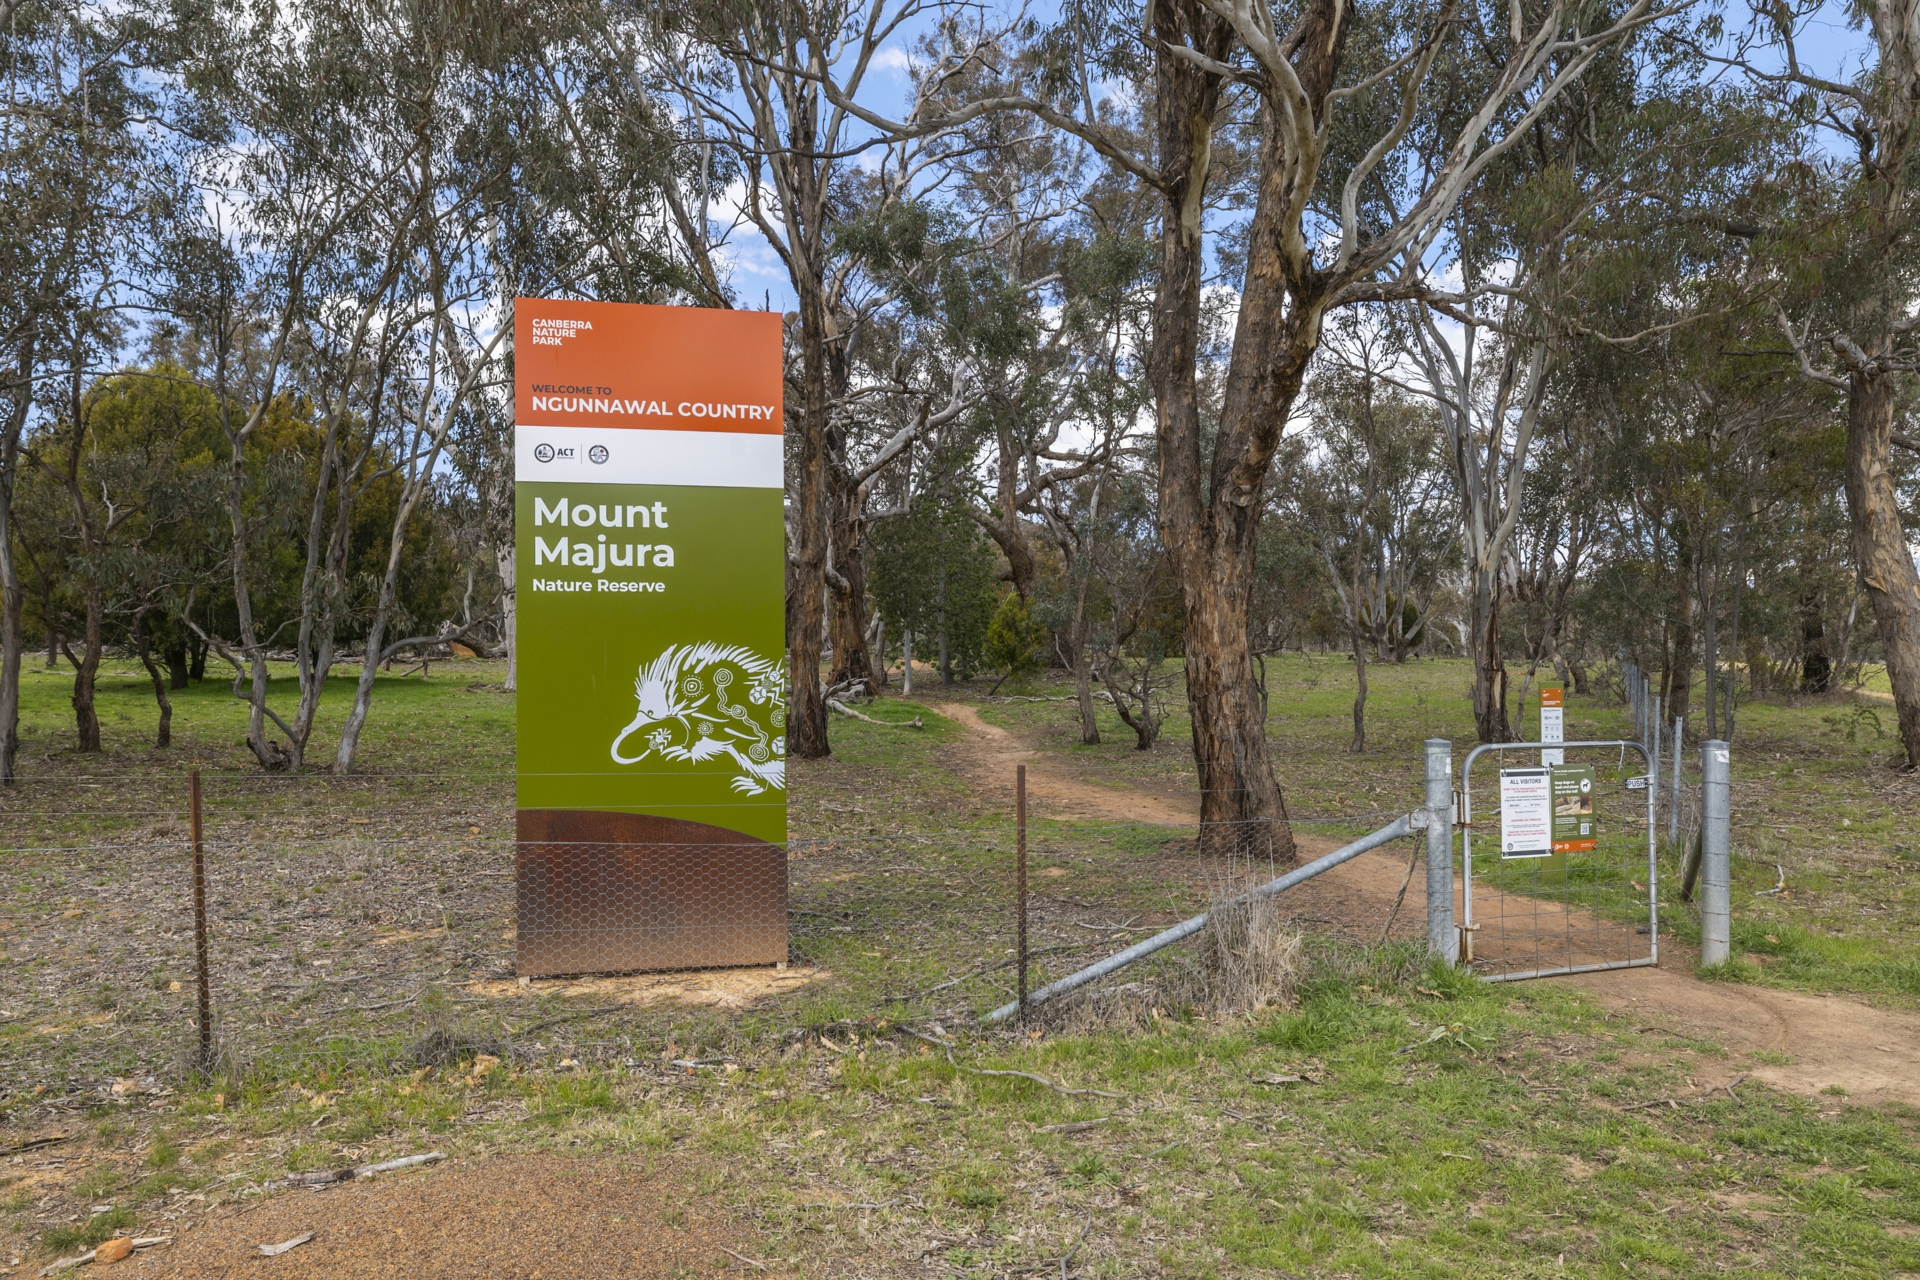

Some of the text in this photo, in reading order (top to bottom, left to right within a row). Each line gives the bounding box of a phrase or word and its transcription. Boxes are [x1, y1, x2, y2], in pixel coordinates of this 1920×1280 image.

[532, 318, 593, 330] CANBERRA
[532, 327, 577, 338] NATURE
[532, 336, 563, 346] PARK
[532, 384, 612, 396] WELCOME TO
[532, 396, 775, 420] NGUNNAWAL COUNTRY
[534, 497, 669, 529] Mount
[534, 534, 675, 574] Majura
[532, 578, 666, 592] Nature Reserve
